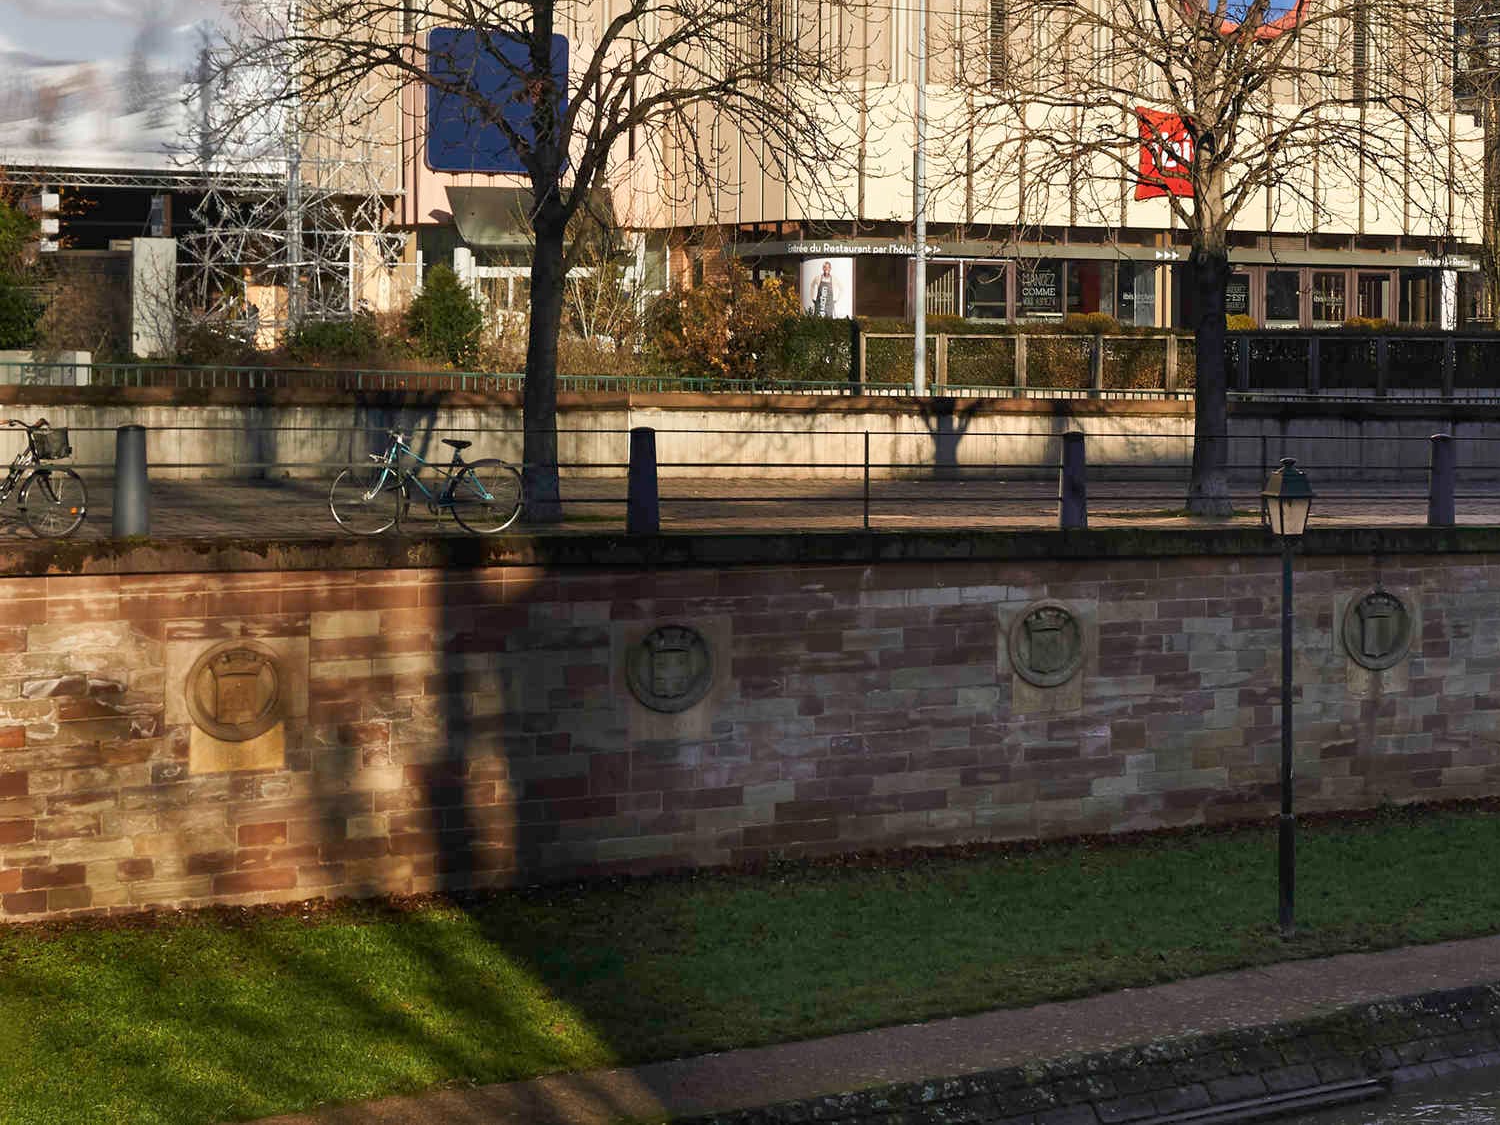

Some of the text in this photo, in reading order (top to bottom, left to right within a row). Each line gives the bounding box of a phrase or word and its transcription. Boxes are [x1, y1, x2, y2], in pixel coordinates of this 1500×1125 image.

[810, 243, 821, 252] du
[823, 243, 871, 253] Restaurant
[1022, 287, 1056, 296] COMME
